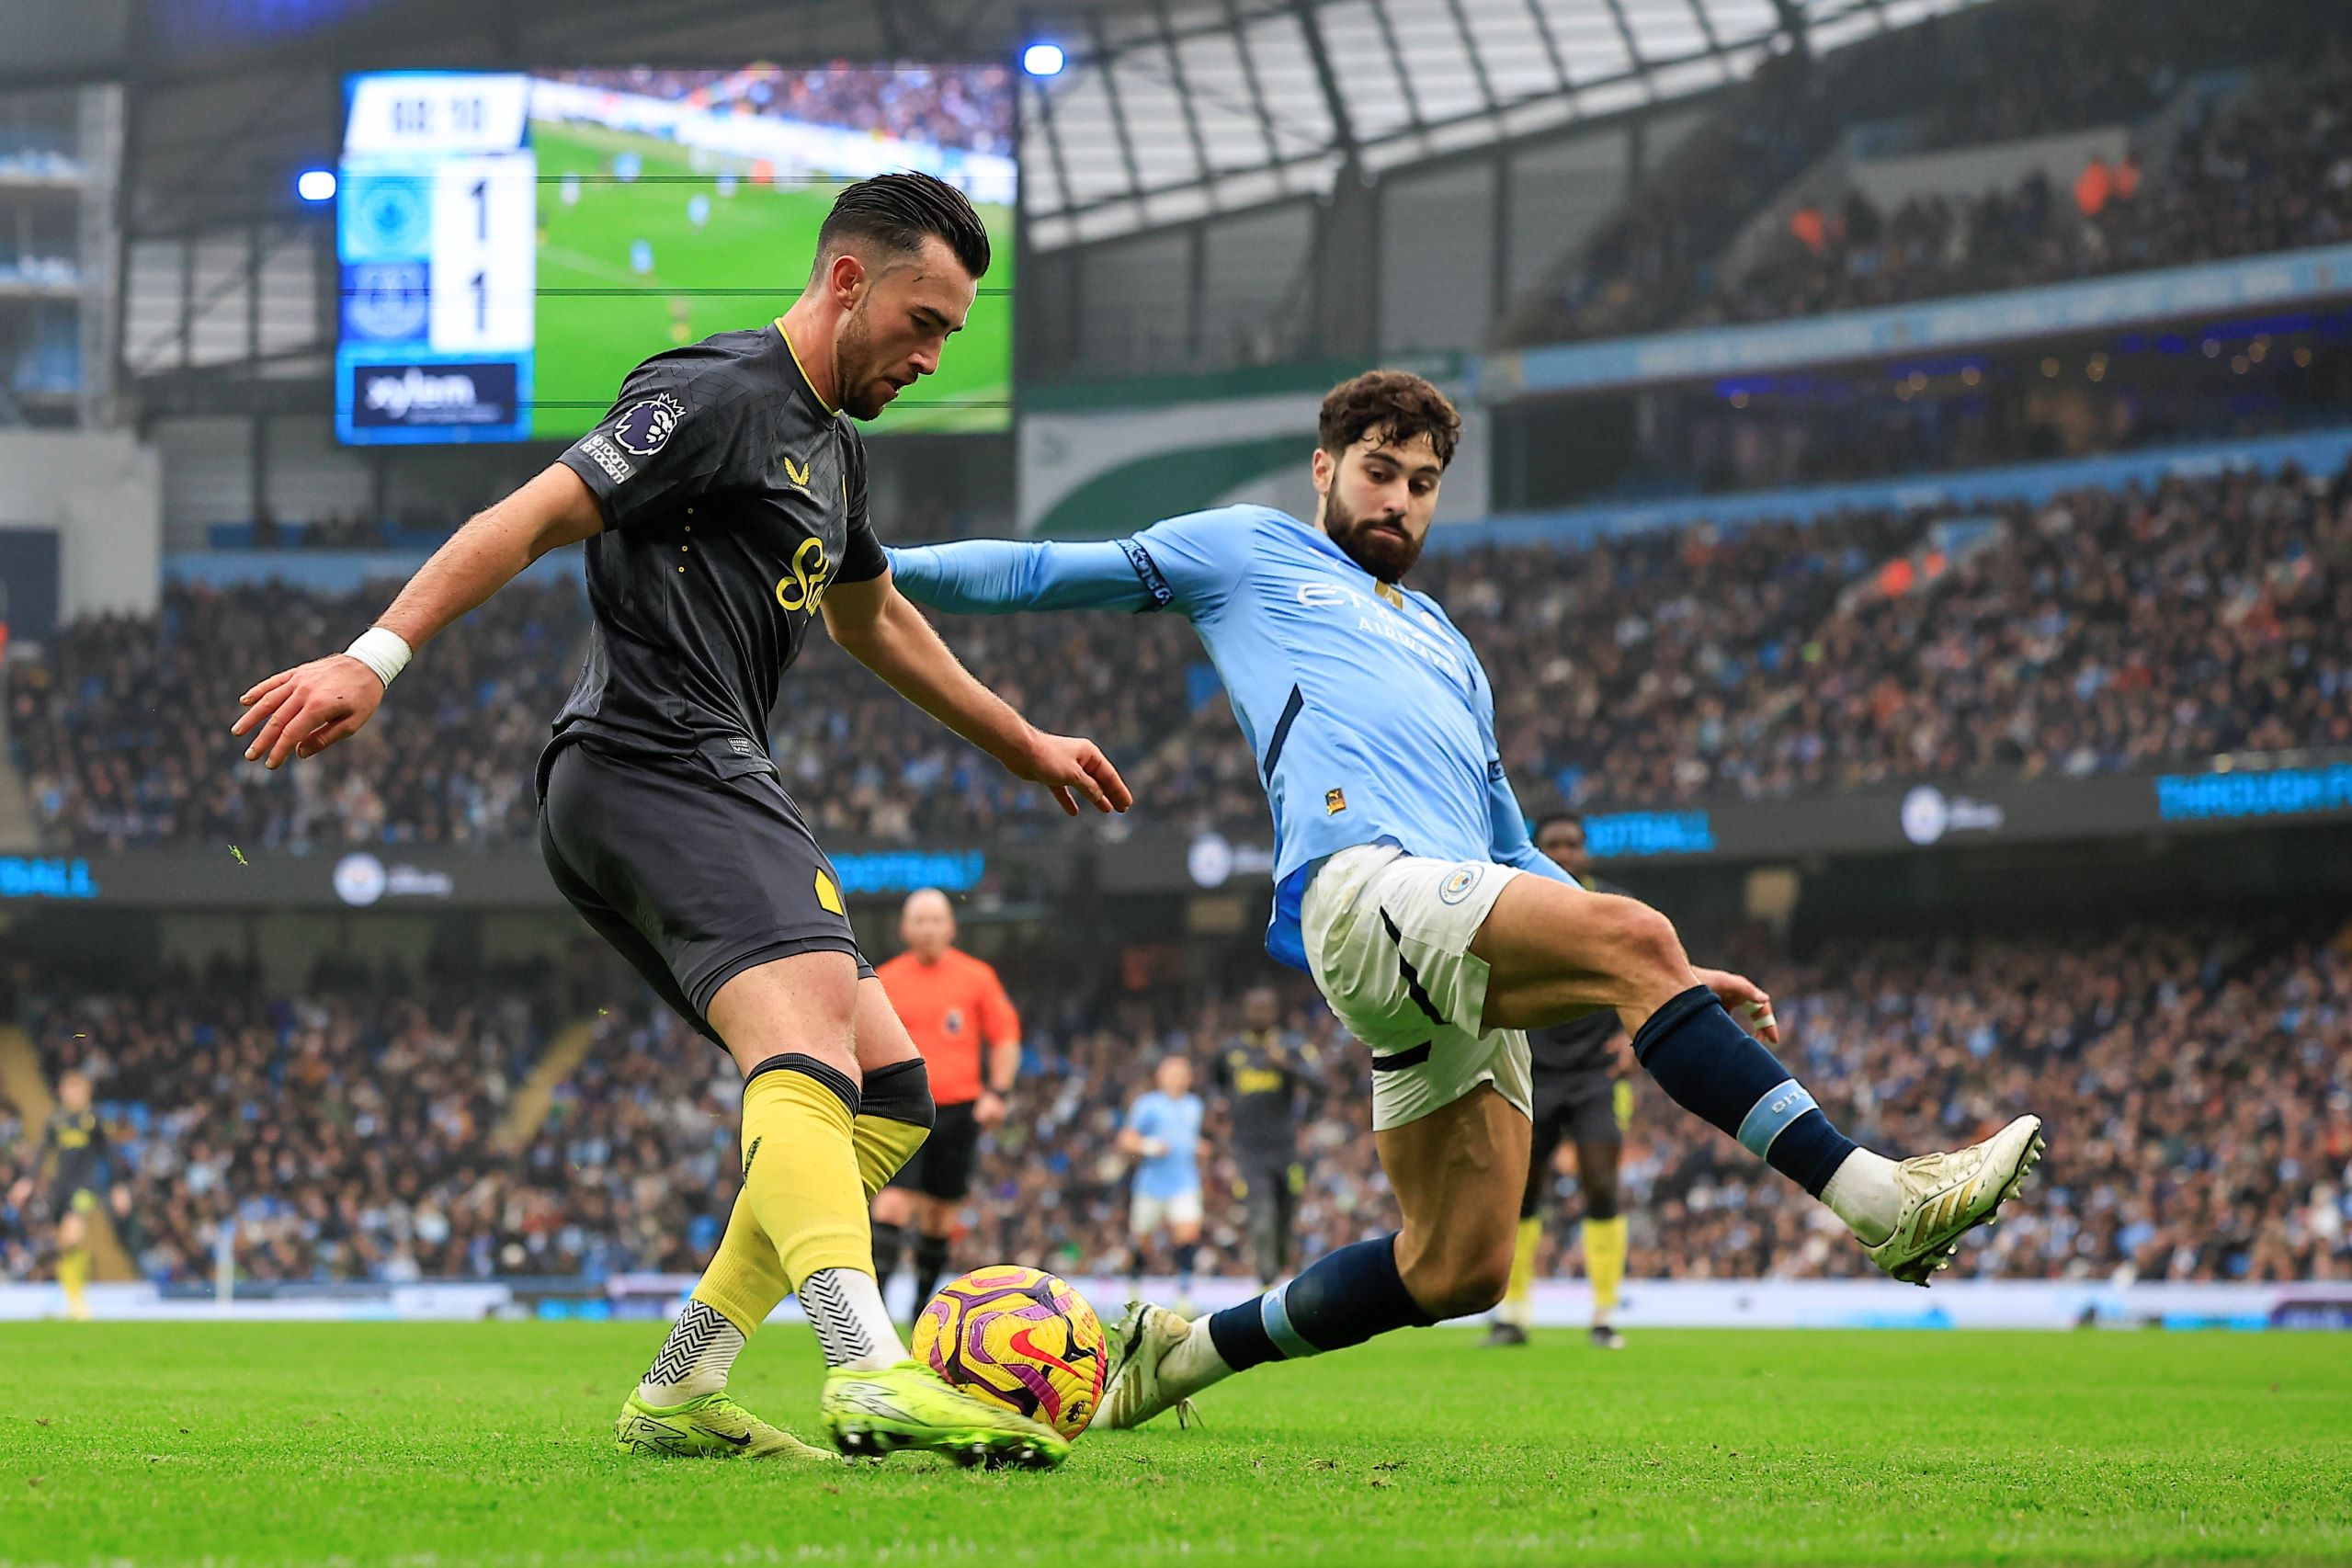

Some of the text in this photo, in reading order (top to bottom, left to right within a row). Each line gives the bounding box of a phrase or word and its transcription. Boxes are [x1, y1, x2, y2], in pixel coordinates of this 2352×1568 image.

[470, 179, 488, 241] 1
[469, 269, 486, 333] 1
[579, 441, 626, 484] for racism
[587, 434, 631, 473] No room
